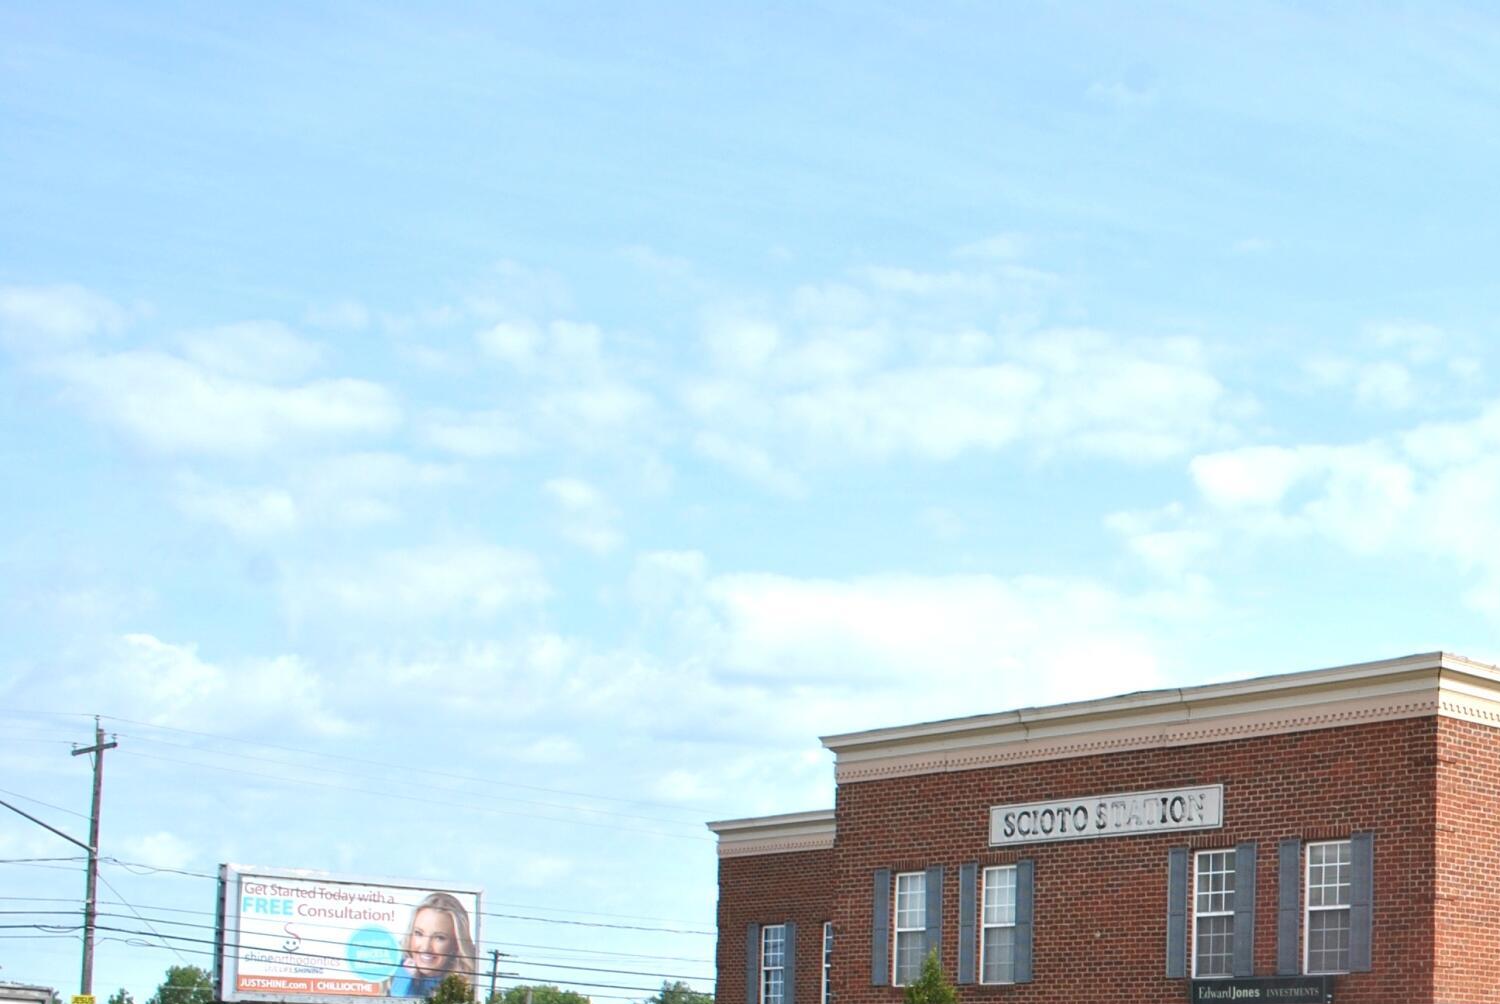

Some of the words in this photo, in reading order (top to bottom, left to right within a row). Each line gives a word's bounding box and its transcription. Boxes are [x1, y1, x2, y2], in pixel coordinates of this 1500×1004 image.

[1003, 805, 1089, 838] SCIOTO
[244, 881, 267, 896] Get
[270, 884, 316, 899] Started
[319, 887, 356, 904] Today
[357, 890, 385, 903] with
[242, 896, 293, 916] FREE
[297, 903, 395, 922] Consultation!
[240, 978, 308, 990] JUSTSHINE.com
[1266, 987, 1320, 998] INVESTMENTS
[72, 996, 95, 1004] JESUS
